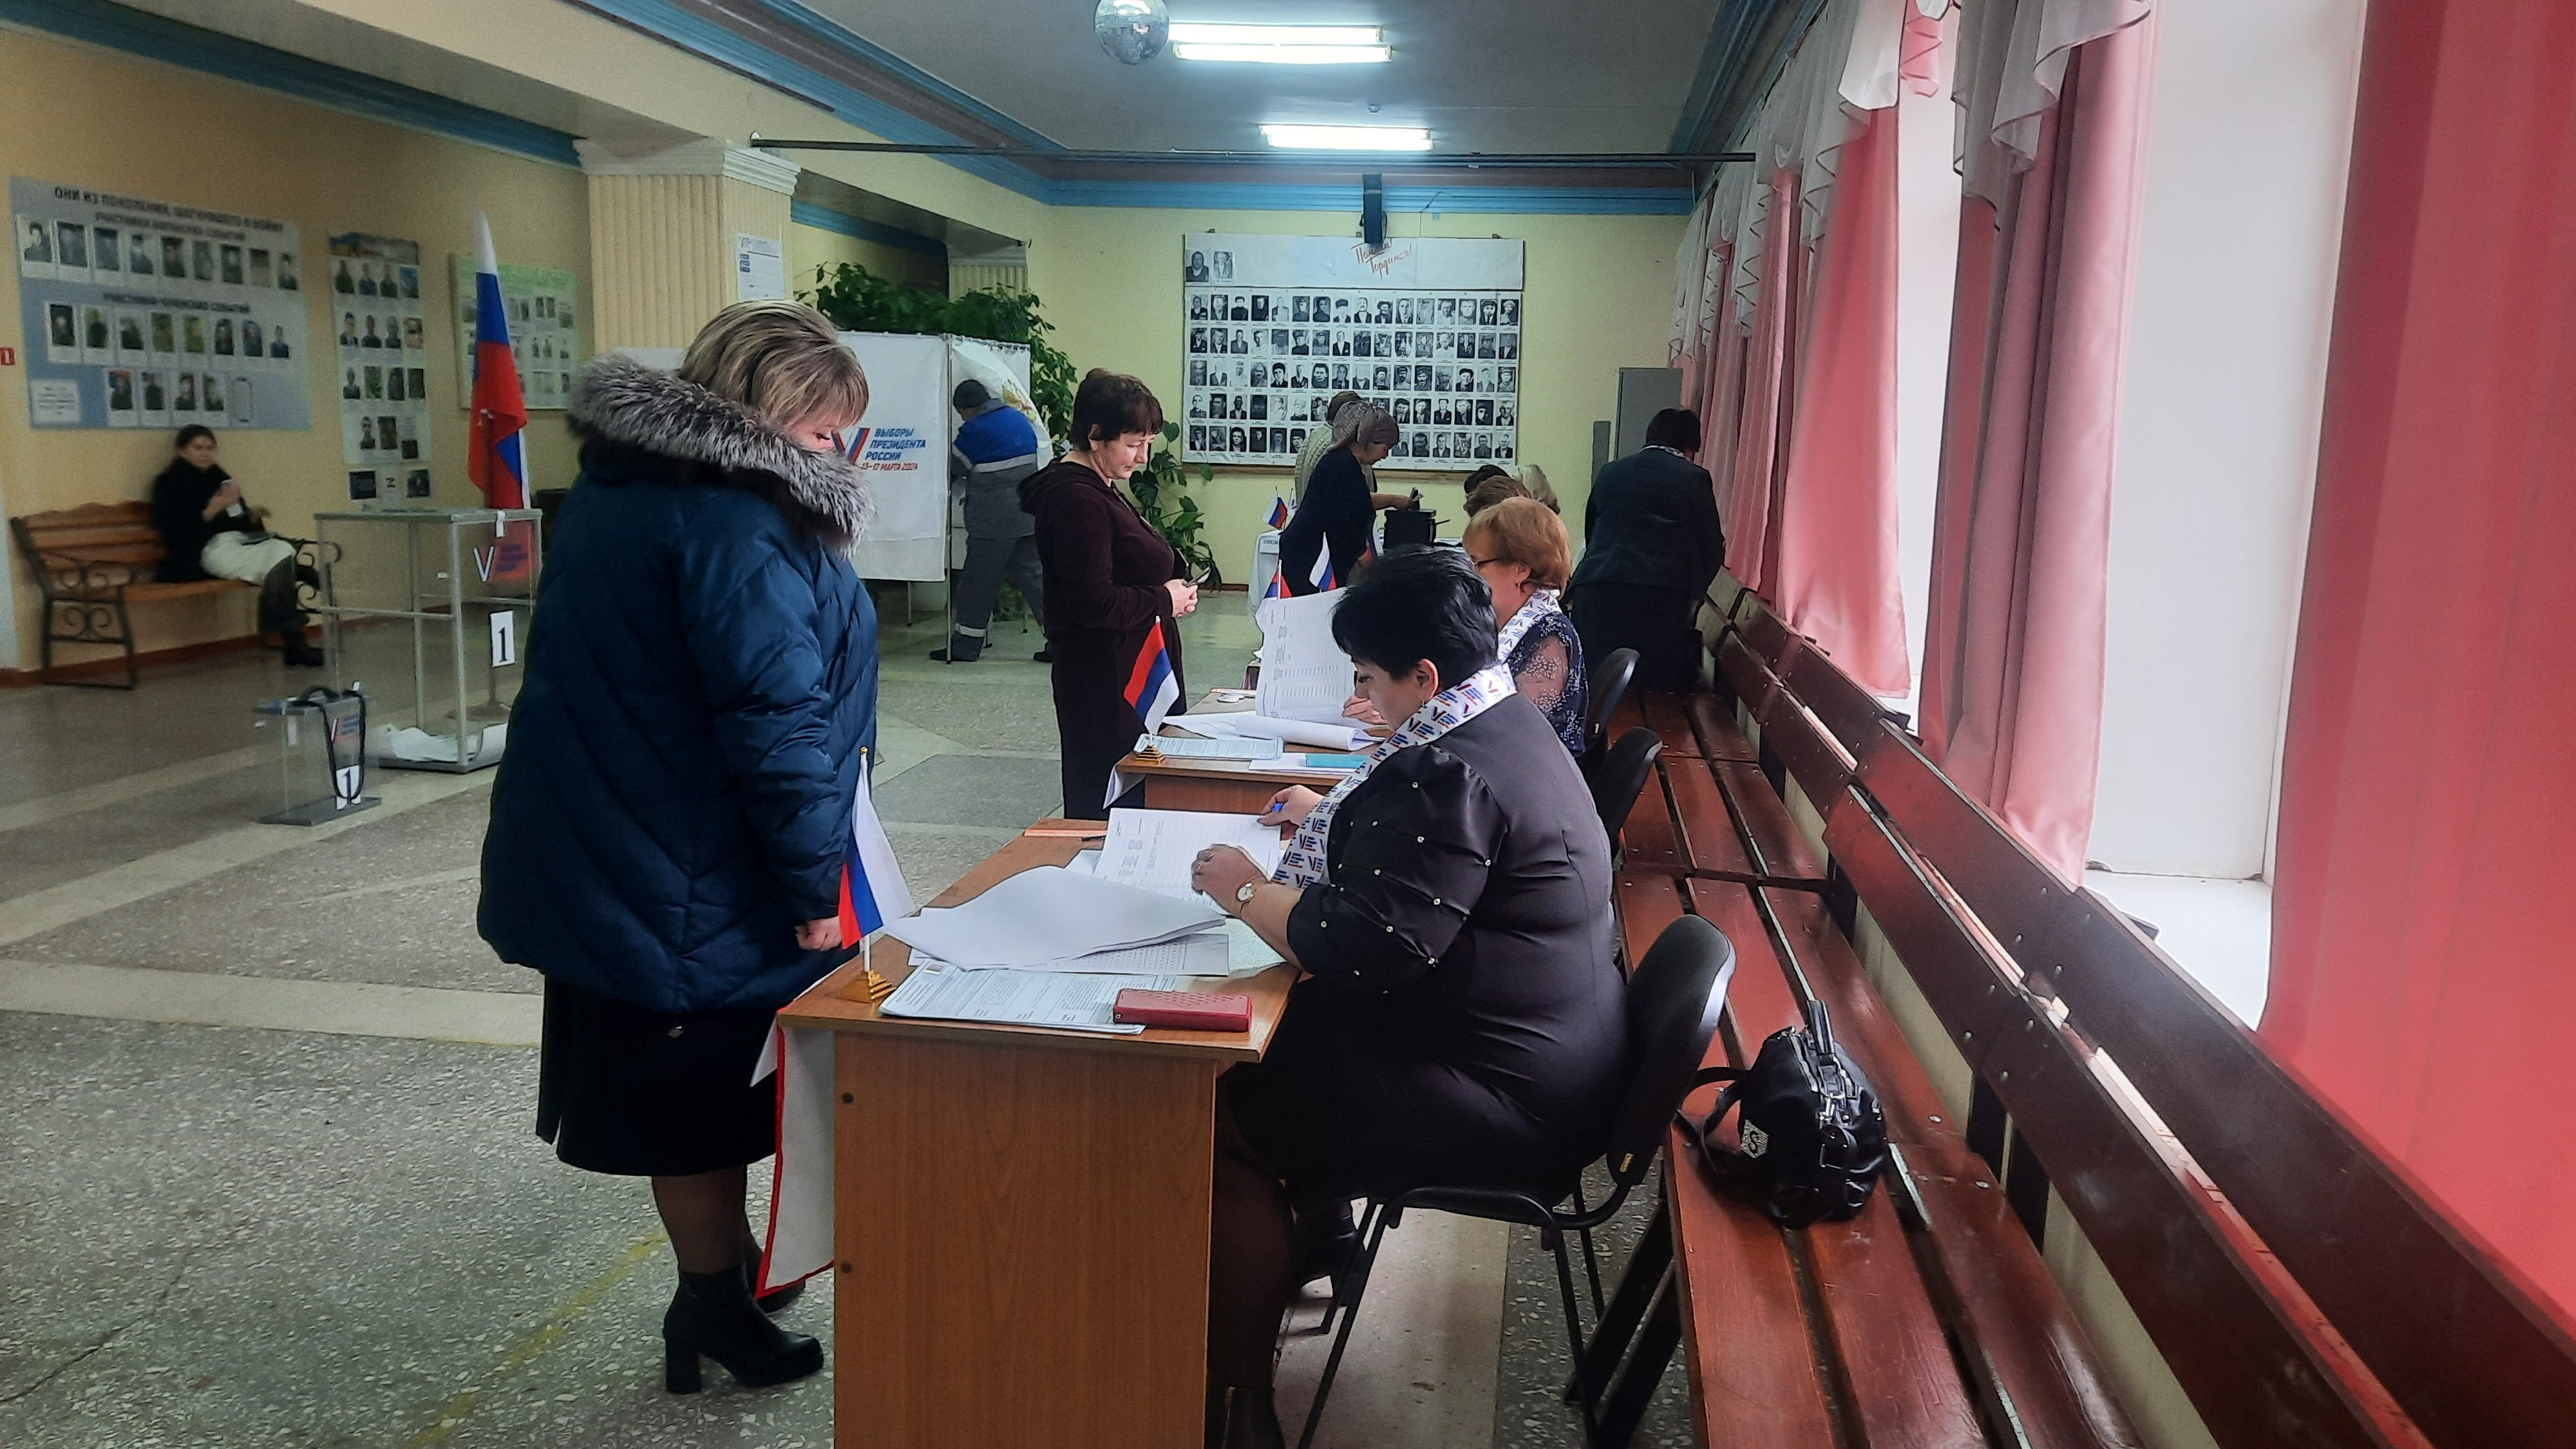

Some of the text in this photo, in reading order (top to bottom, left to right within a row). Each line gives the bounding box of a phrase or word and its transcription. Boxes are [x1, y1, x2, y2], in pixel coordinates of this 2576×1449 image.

[55, 187, 79, 200] ОНИ
[84, 191, 99, 204] ИЗ
[875, 428, 914, 437] ВЫБОРЫ
[870, 439, 926, 450] ПРЕЗИДЕНТА
[865, 451, 902, 460] РОССИИ
[498, 627, 509, 663] 1
[341, 768, 352, 804] 1
